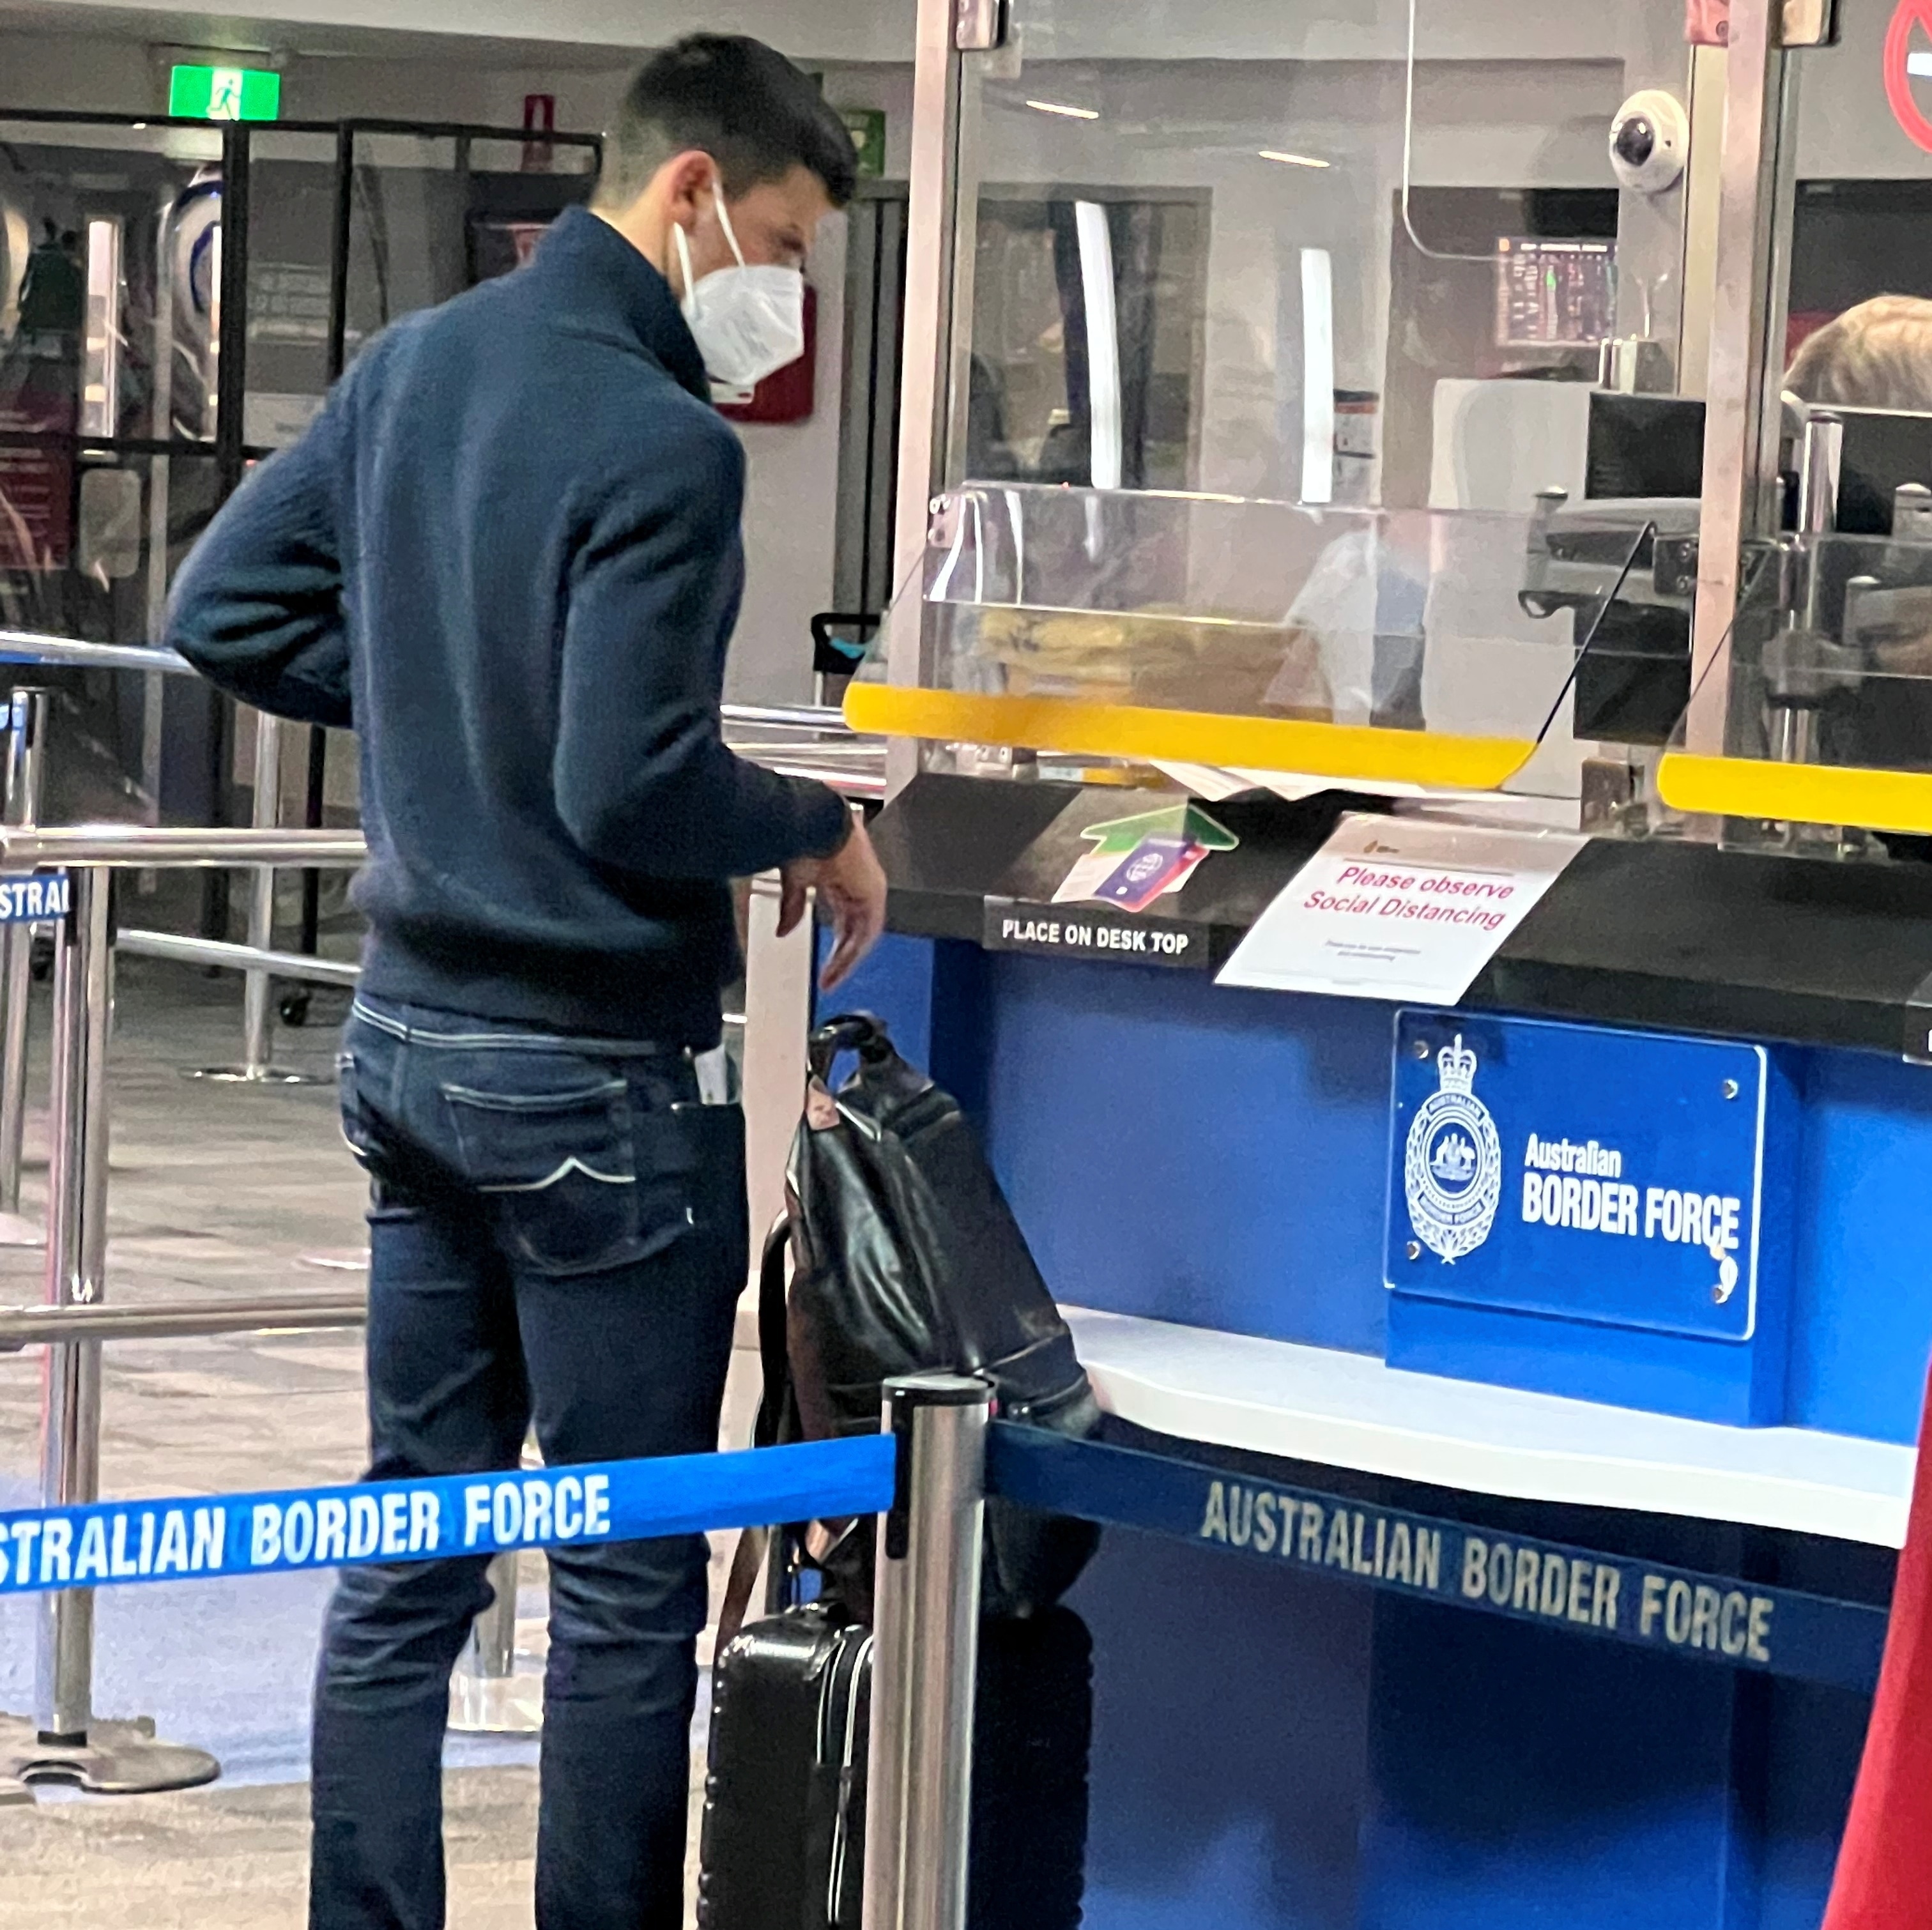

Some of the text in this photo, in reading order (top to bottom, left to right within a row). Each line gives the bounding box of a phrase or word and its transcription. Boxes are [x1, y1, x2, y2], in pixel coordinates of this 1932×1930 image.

[1336, 866, 1514, 900] Please observe
[1304, 891, 1506, 931] Social Distancing
[1002, 919, 1189, 955] PLACE ON DESK TOP
[1524, 1133, 1621, 1178] Australian
[1522, 1172, 1639, 1236] BORDER
[1644, 1187, 1740, 1250] FORCE
[250, 1490, 440, 1566] BORDER
[464, 1474, 611, 1547] FORCE
[1200, 1481, 1774, 1662] AUSTRALIAN BORDER FORCE
